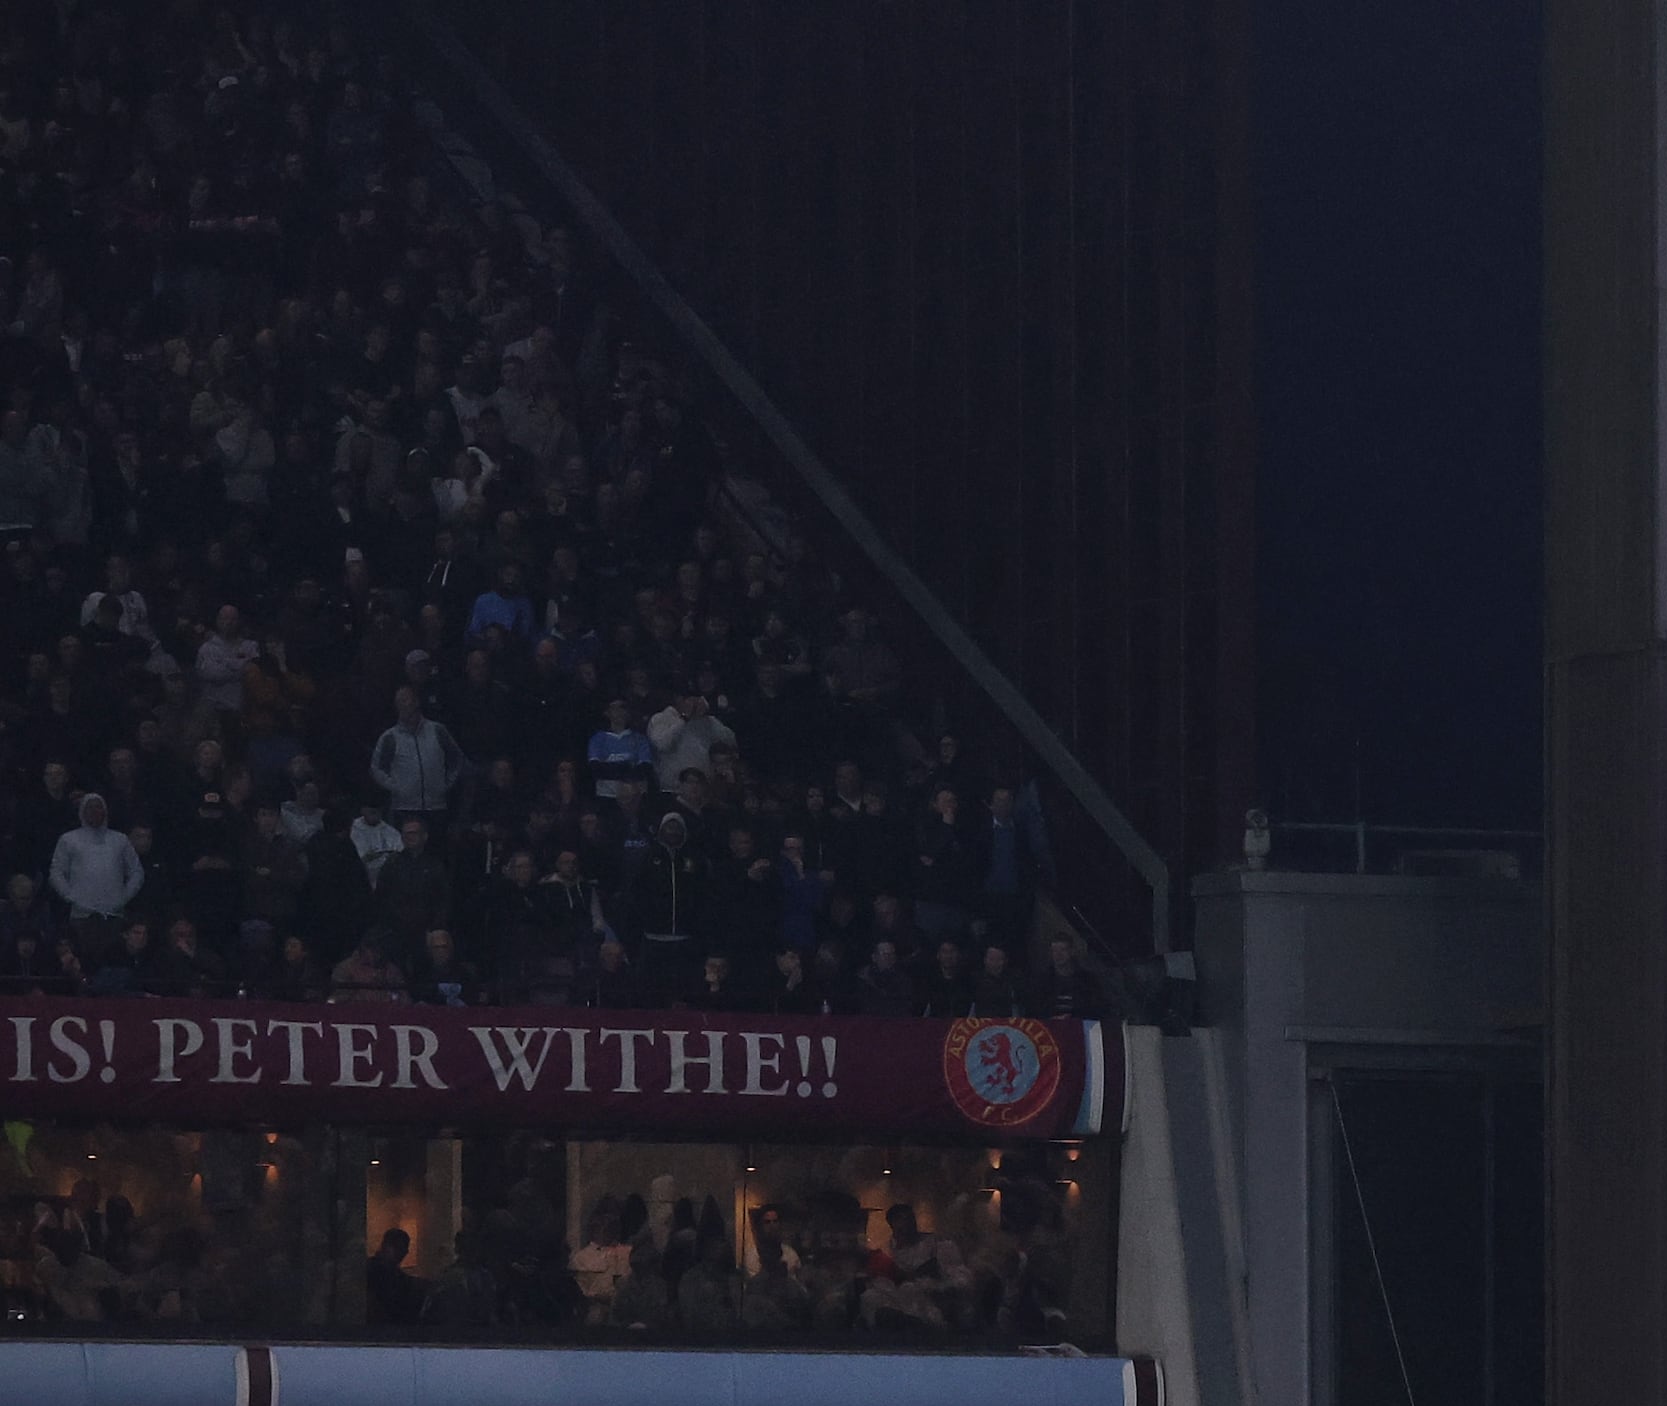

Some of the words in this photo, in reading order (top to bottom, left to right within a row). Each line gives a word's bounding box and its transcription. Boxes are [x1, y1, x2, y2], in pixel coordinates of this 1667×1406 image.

[7, 1017, 115, 1083] IS!
[153, 1019, 448, 1089] PETER
[469, 1027, 840, 1098] WITHE!!
